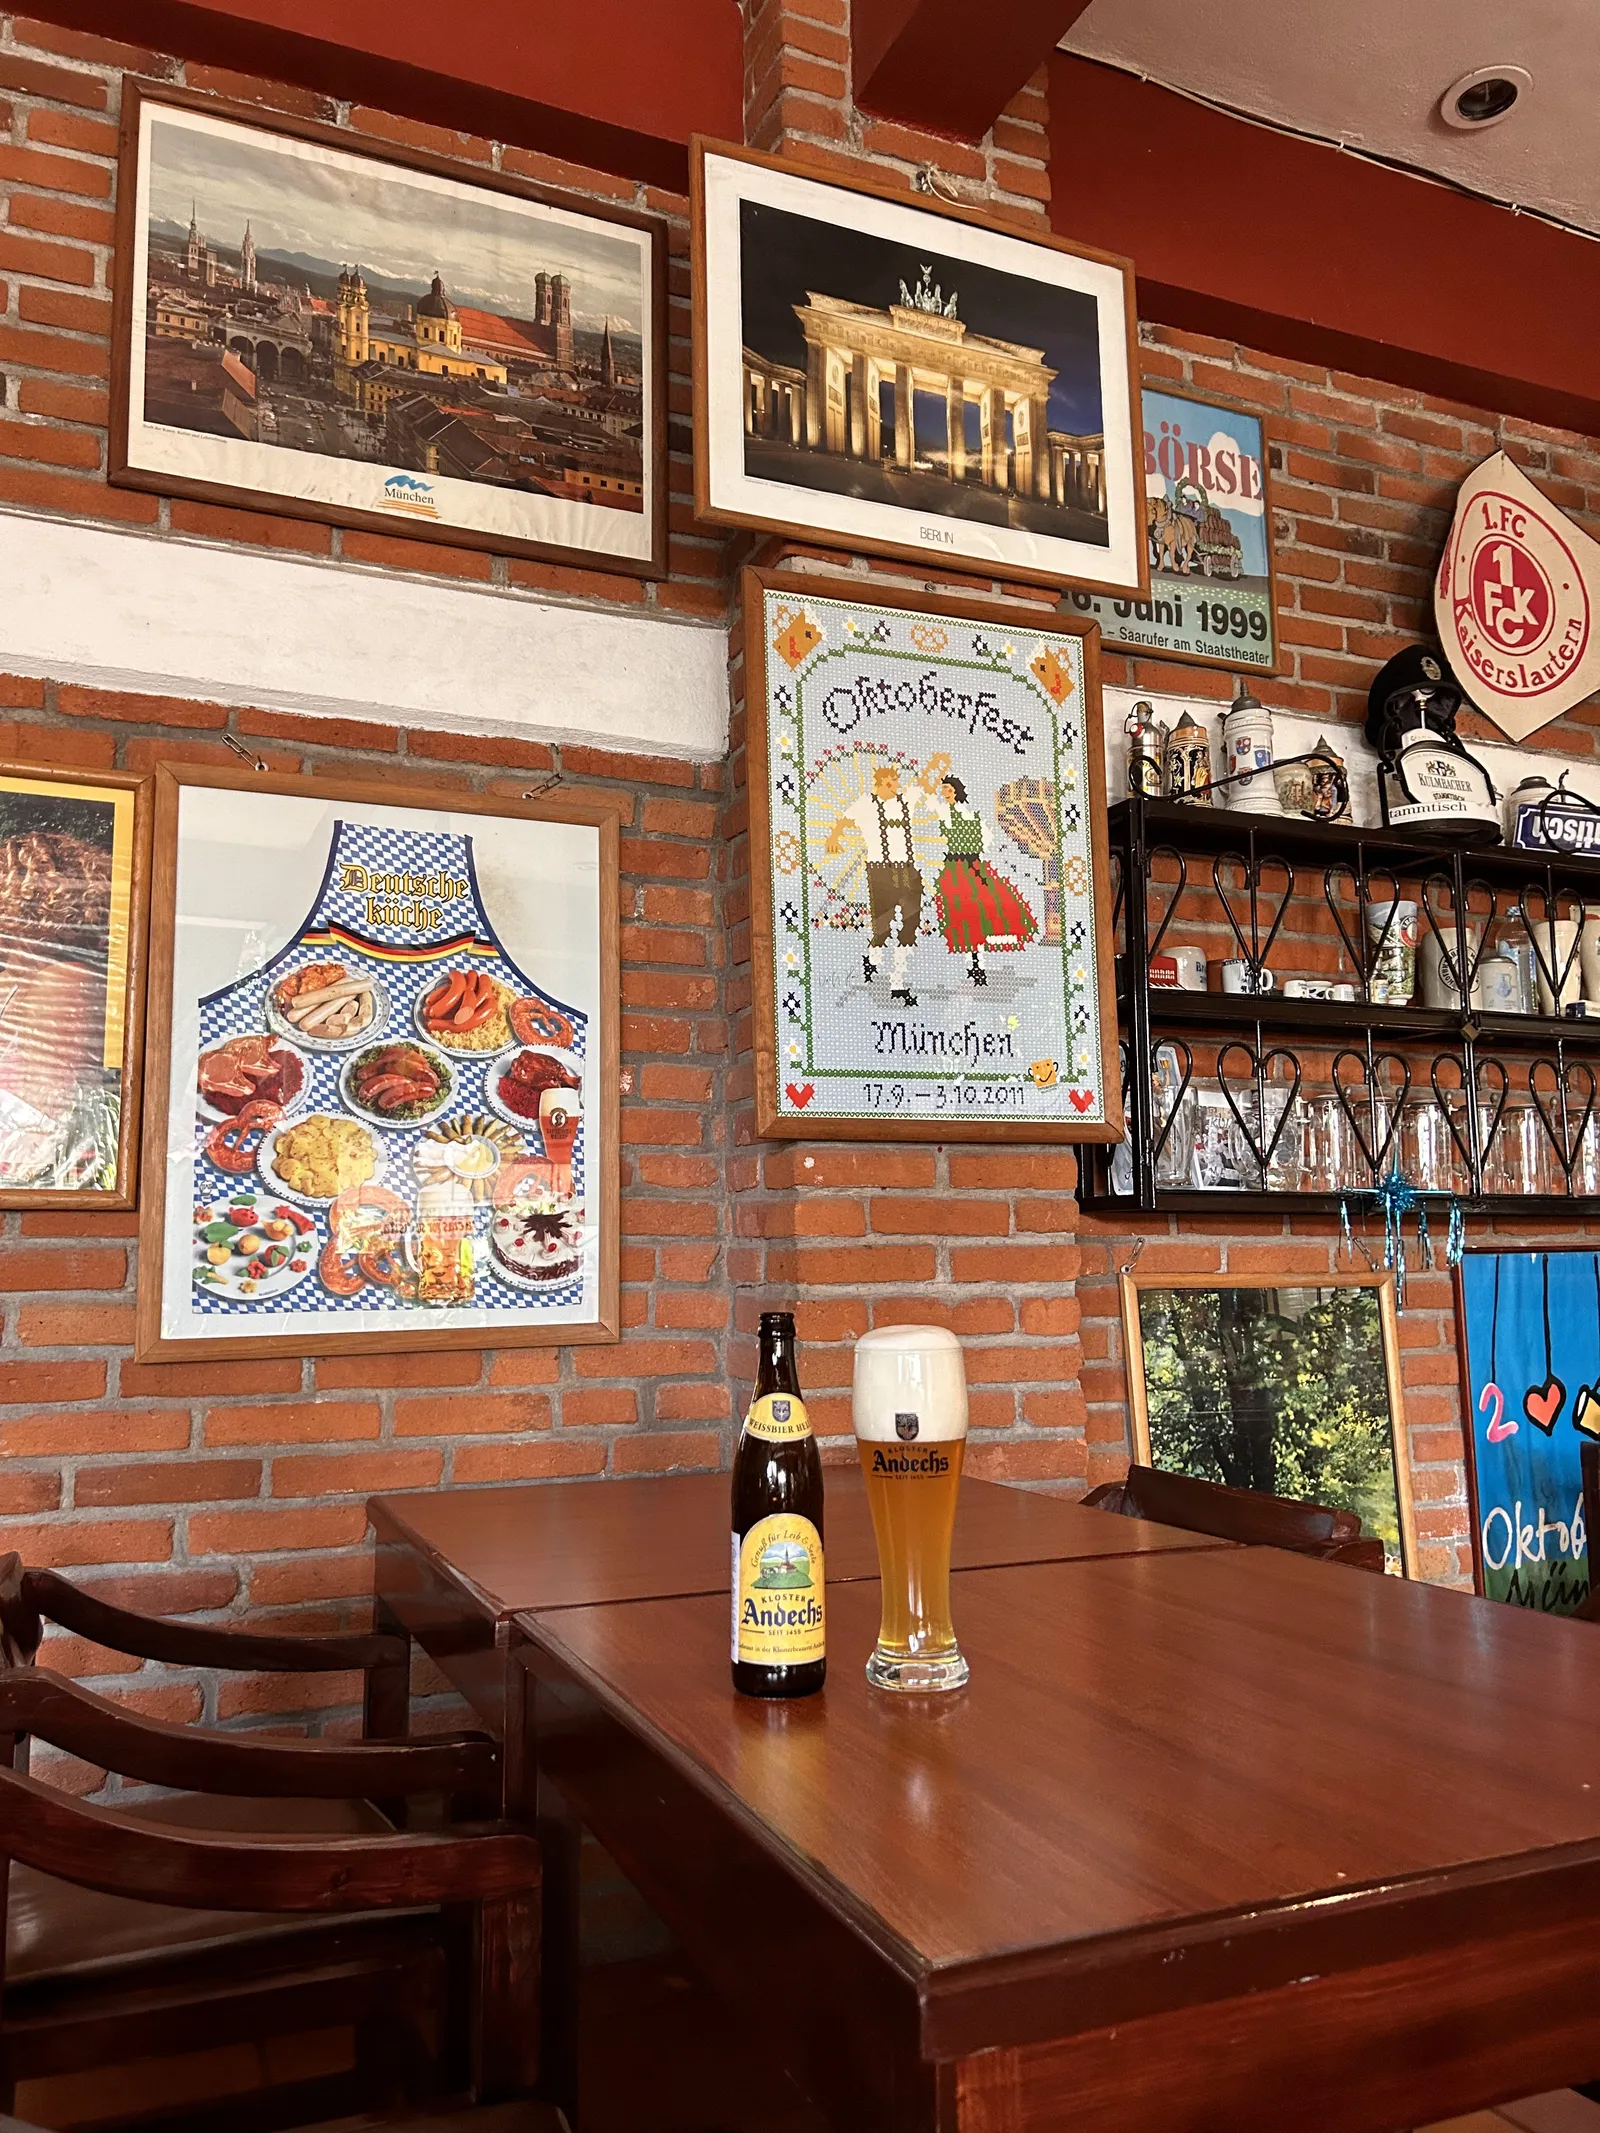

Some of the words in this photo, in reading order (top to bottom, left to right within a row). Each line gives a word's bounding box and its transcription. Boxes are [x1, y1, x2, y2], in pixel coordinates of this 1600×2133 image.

[384, 487, 434, 505] München
[920, 526, 954, 545] BERLIN
[1197, 601, 1268, 642] 1999
[1119, 627, 1169, 650] Saarufer
[1173, 637, 1191, 651] am
[1195, 640, 1270, 665] Staatstheater
[1455, 598, 1582, 689] Kaiserslautern
[822, 671, 1034, 755] Oktoberfest
[1417, 772, 1473, 793] KULMBACHER
[1390, 801, 1468, 819] tammtisch
[339, 862, 469, 904] Deutsche
[366, 896, 443, 932] küche
[871, 1021, 1014, 1068] München
[750, 1417, 794, 1434] WEISSBIER
[1479, 1382, 1519, 1443] 2
[872, 1449, 949, 1474] Andechs
[888, 1445, 928, 1454] KLOSTER
[751, 1537, 768, 1568] Genuß
[767, 1533, 780, 1545] für
[783, 1529, 801, 1540] Leib
[807, 1543, 817, 1564] Seele
[1482, 1492, 1587, 1570] Oktob
[761, 1593, 806, 1604] KLOSTER
[1506, 1560, 1589, 1611] Mün
[741, 1596, 823, 1627] Andechs
